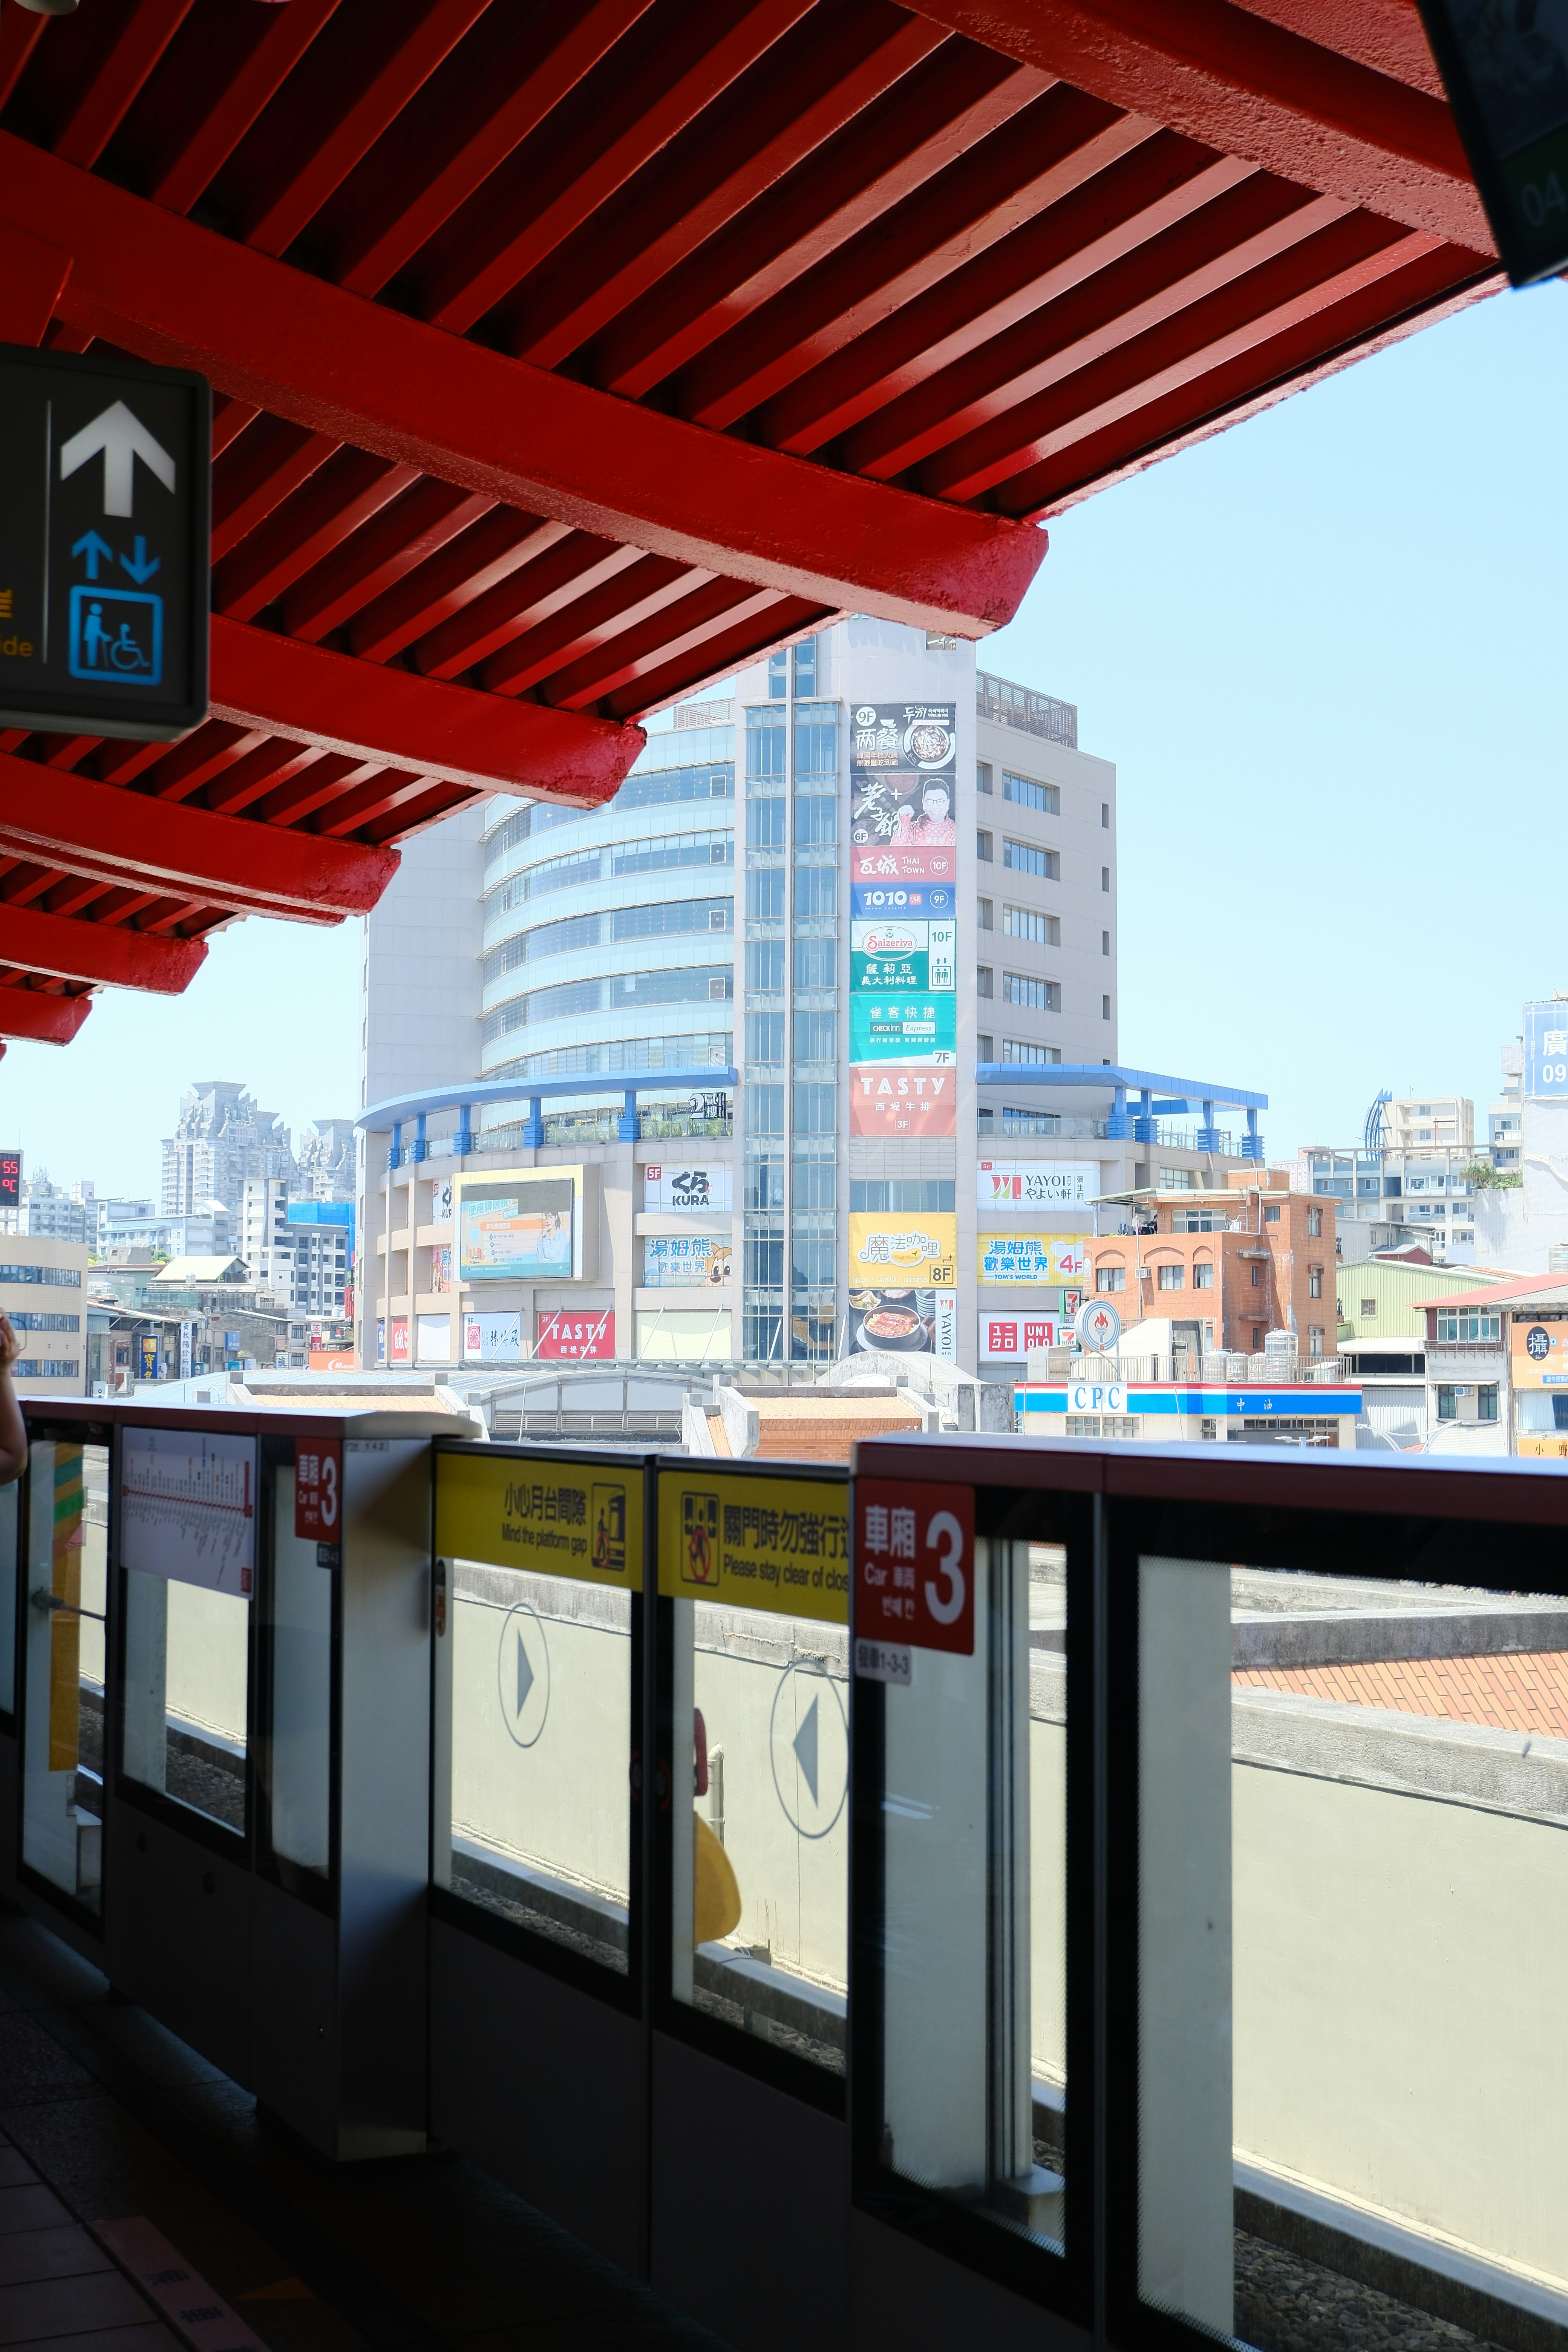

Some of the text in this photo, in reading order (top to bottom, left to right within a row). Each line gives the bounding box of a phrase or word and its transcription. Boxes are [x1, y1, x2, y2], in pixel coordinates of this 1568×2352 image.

[858, 711, 874, 723] 9F
[860, 855, 899, 875] 瓦城
[864, 891, 907, 905] 1010
[934, 895, 945, 903] 9F
[867, 936, 913, 950] Saizeriya
[931, 931, 952, 942] 10F
[866, 963, 913, 974] 薩莉亞
[861, 975, 918, 985] 義大利料理
[870, 1006, 936, 1018] 雀客快捷
[935, 1052, 950, 1063] 7F
[861, 1077, 945, 1095] TASTY
[689, 1093, 704, 1119] 2
[706, 1093, 717, 1118] 貳樓
[875, 1102, 931, 1112] 西堤牛排
[648, 1169, 660, 1178] 5F
[1025, 1175, 1065, 1186] YAYOI
[672, 1171, 709, 1194] くら
[672, 1195, 710, 1206] KURA
[1025, 1188, 1072, 1200] やよい軒
[650, 1239, 712, 1257] 湯姆熊
[860, 1233, 937, 1260] 魔法咖哩
[989, 1240, 1043, 1255] 湯姆熊
[658, 1261, 705, 1274] 歡樂世界
[984, 1256, 1048, 1271] 歡樂世界
[1060, 1255, 1082, 1273] 4F
[646, 1274, 659, 1285] 4F
[933, 1268, 951, 1281] 8F
[551, 1324, 607, 1340] TASTY
[942, 1312, 951, 1349] YAYOI
[1027, 1325, 1048, 1336] UNI
[560, 1345, 597, 1354] 西堤牛排
[1075, 1387, 1120, 1409] CPC
[1236, 1397, 1272, 1412] 中油
[322, 1456, 337, 1526] 3
[504, 1482, 586, 1525] 小心月台間隙
[865, 1504, 916, 1559] 車廂
[502, 1523, 587, 1558] Mind the platform gap
[723, 1554, 756, 1578] Please
[760, 1560, 781, 1586] stay
[783, 1562, 808, 1587] clear
[812, 1567, 824, 1588] of
[864, 1561, 888, 1586] Car
[925, 1510, 966, 1625] 3
